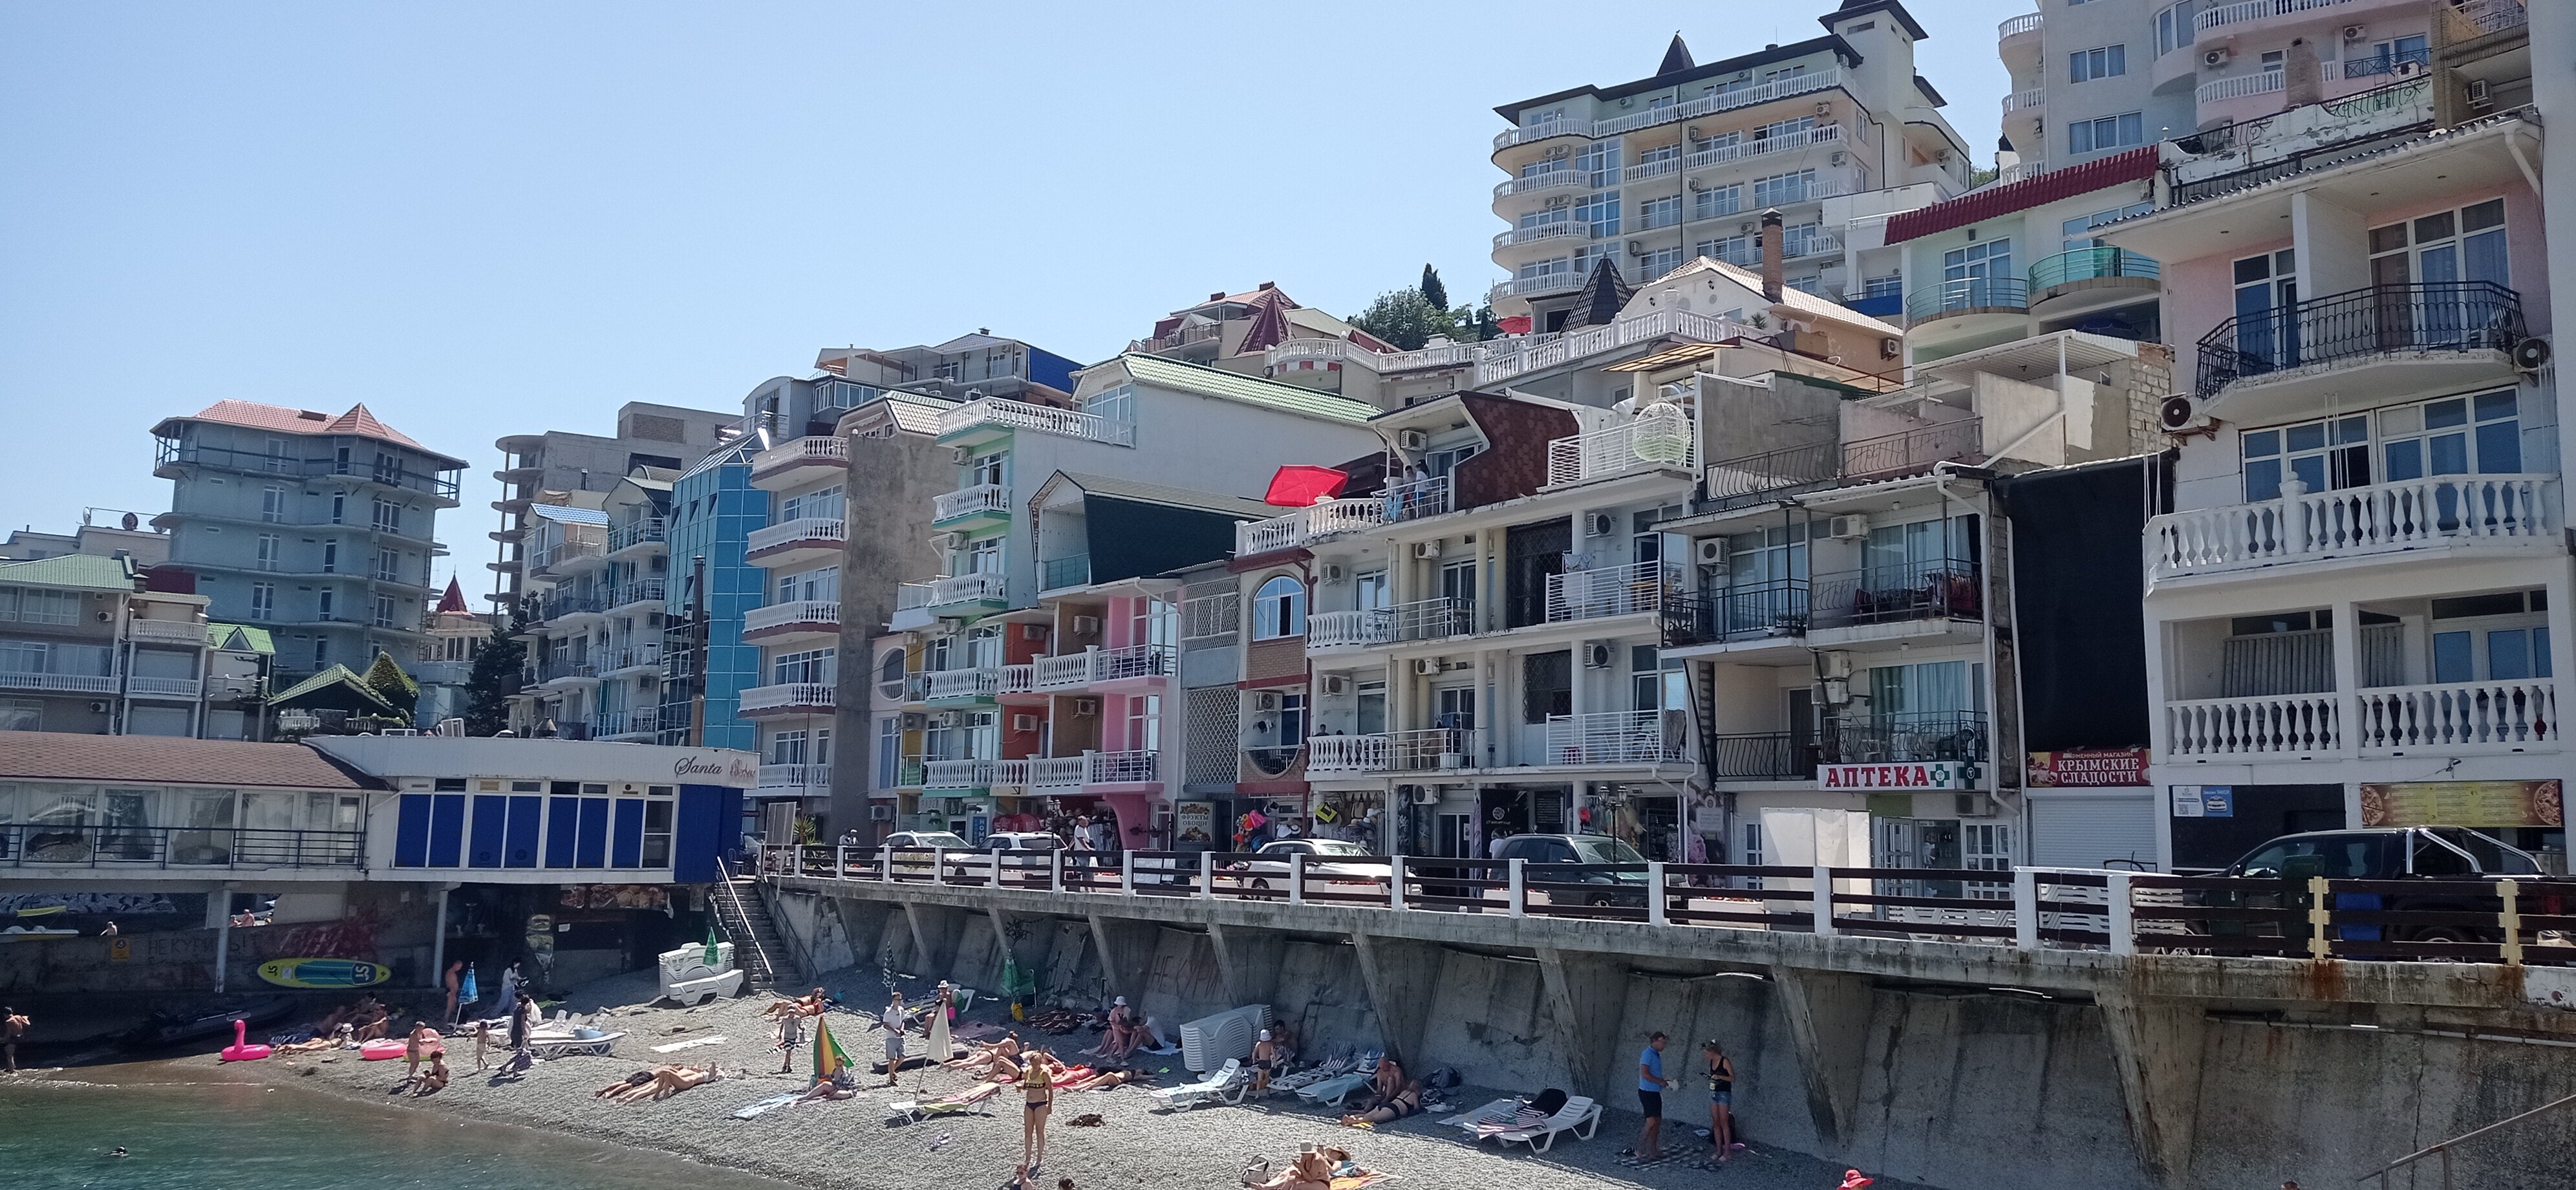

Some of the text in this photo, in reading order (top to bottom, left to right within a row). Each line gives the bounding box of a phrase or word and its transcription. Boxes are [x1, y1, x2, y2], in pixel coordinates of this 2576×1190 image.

[674, 756, 722, 778] Santa
[2057, 759, 2140, 772] КРЫМСКИЕ
[1825, 766, 1929, 787] АПТЕКА
[2061, 771, 2138, 785] СЛАДОСТИ
[171, 935, 246, 954] КУРИЬ!
